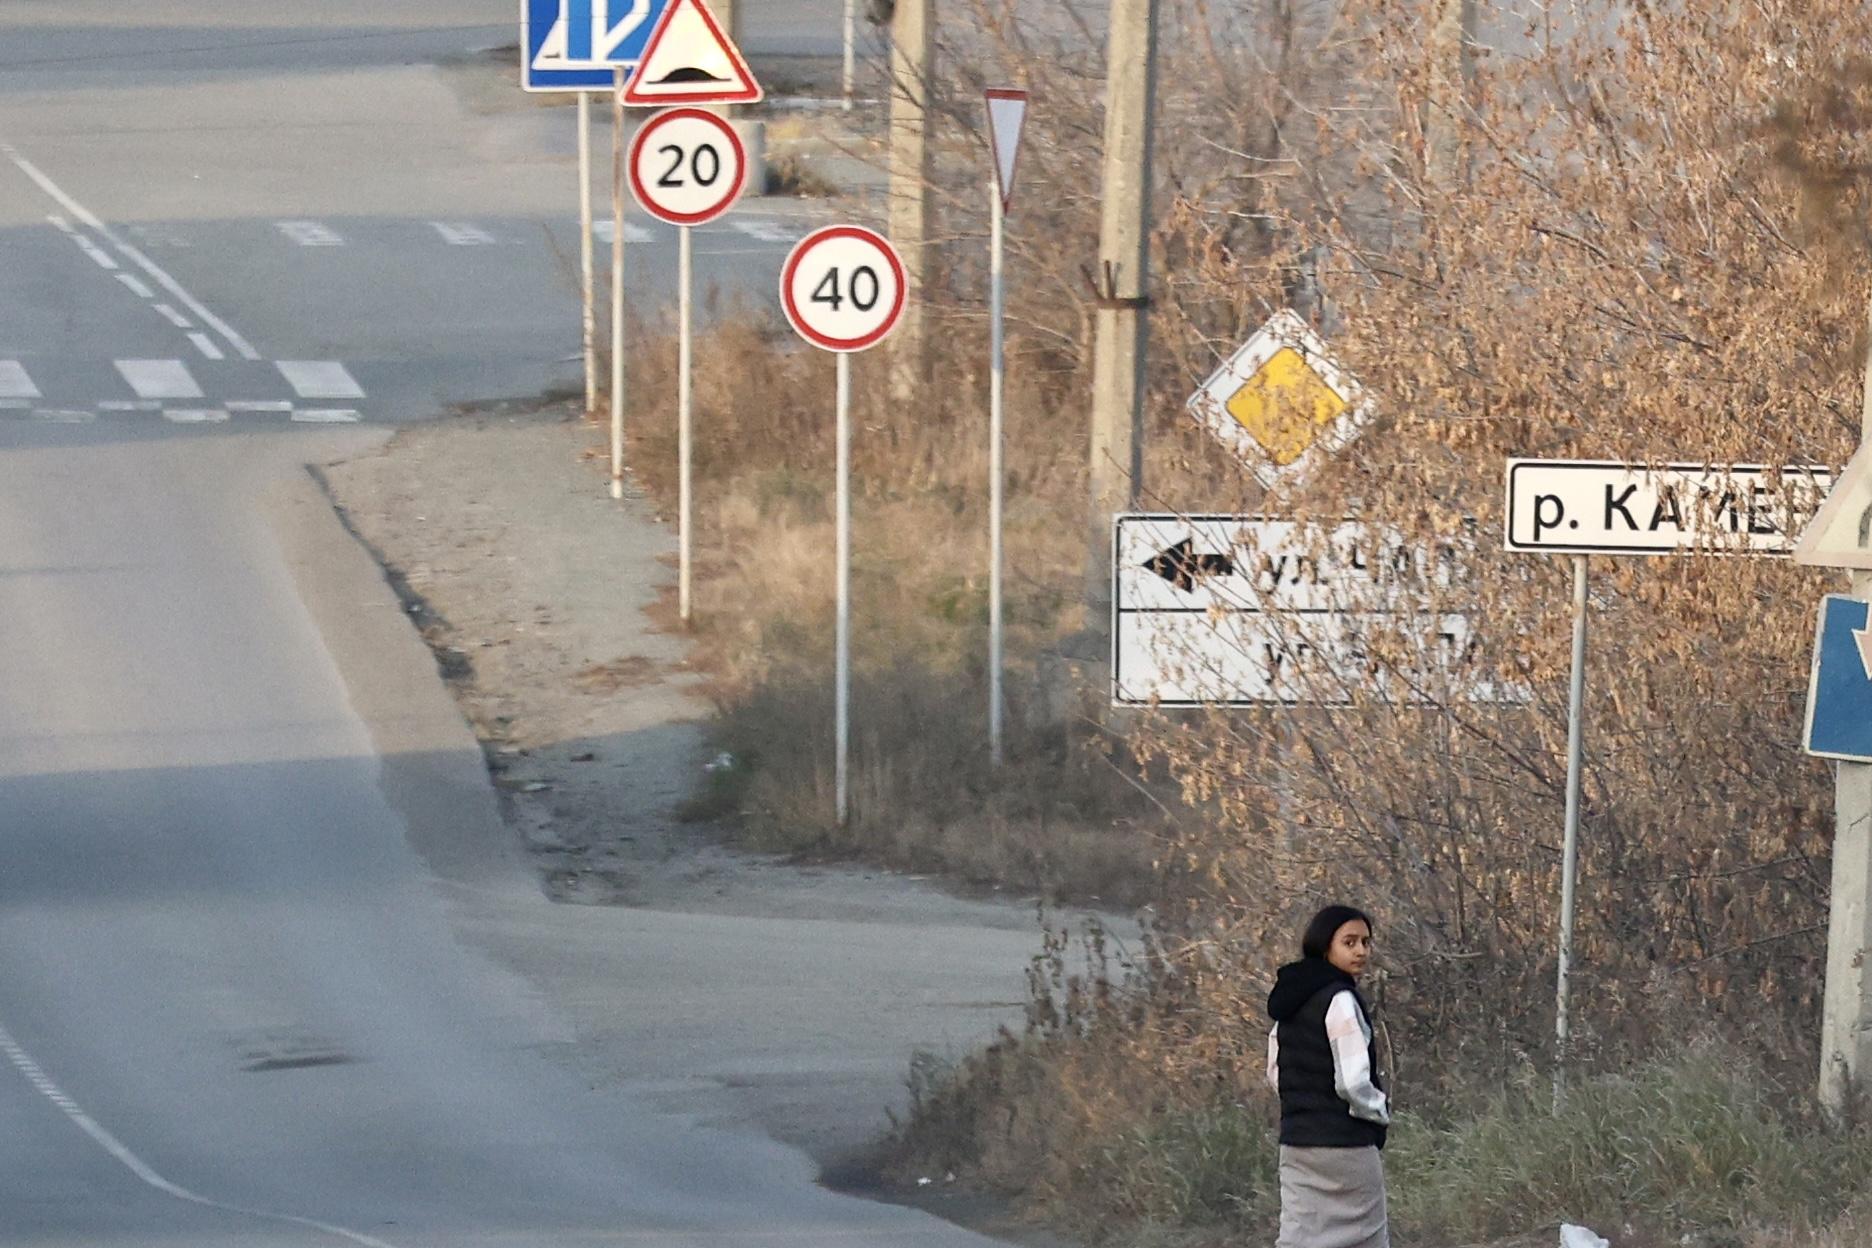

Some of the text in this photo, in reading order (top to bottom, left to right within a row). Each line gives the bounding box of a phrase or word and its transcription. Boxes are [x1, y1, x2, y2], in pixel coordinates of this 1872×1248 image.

[657, 143, 720, 188] 20
[810, 265, 879, 312] 40
[1533, 483, 1822, 542] р. КАМЕ
